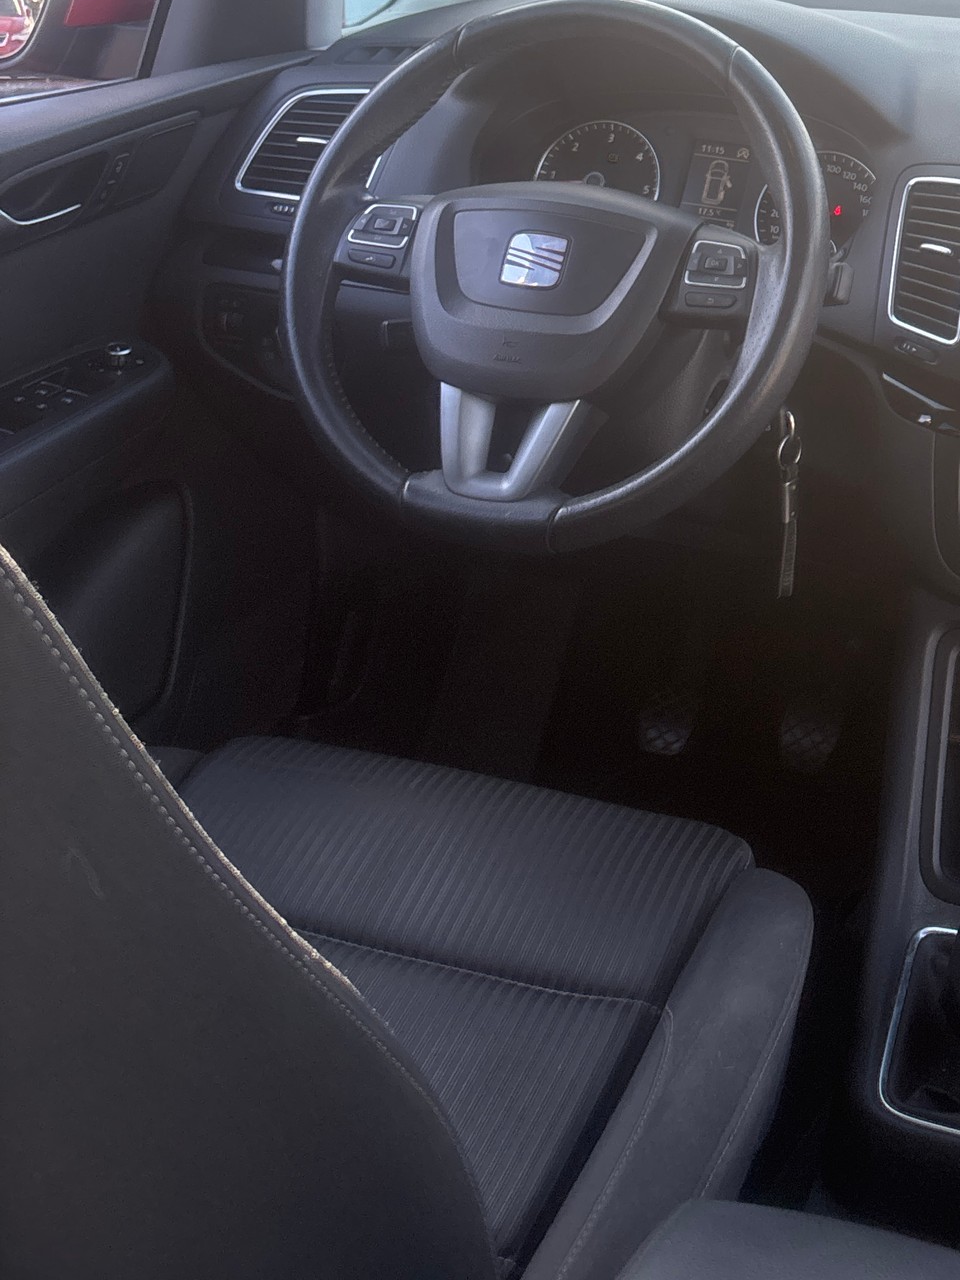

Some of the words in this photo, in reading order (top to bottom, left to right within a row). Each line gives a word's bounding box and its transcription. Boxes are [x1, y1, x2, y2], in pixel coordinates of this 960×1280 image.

[608, 133, 615, 142] 3
[572, 142, 579, 152] 2
[701, 144, 725, 155] 11:15
[635, 152, 644, 161] 4
[827, 164, 841, 174] 100
[551, 170, 556, 179] 1
[842, 171, 856, 181] 120
[643, 185, 650, 195] 5
[853, 182, 868, 192] 140
[770, 225, 779, 234] 10
